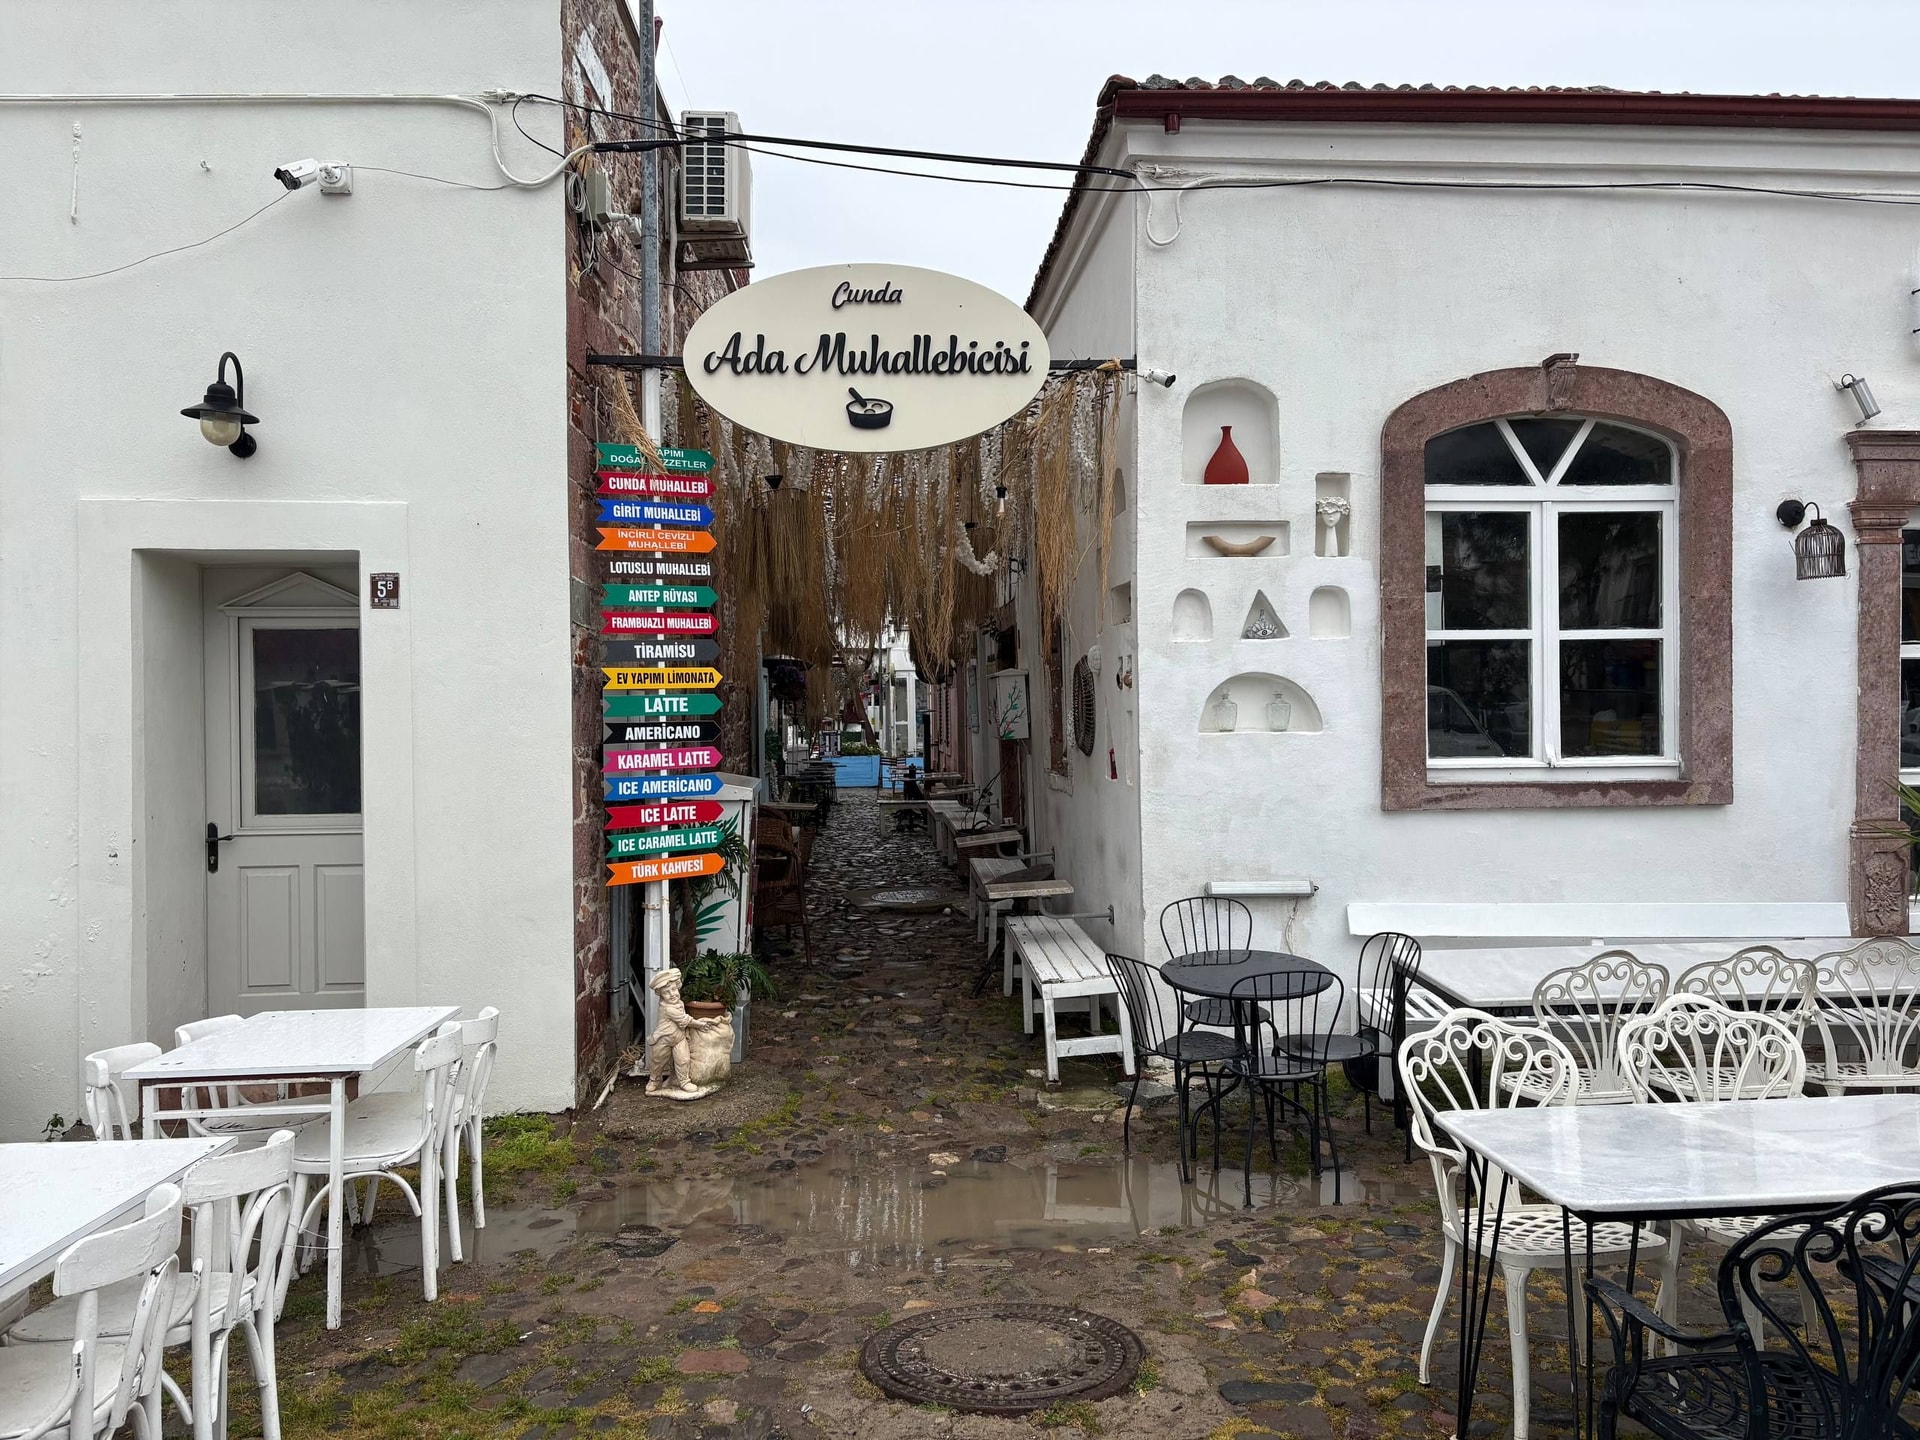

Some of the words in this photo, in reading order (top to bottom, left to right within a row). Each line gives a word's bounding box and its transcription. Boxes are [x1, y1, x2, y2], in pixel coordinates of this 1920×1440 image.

[831, 281, 903, 309] Cunda
[703, 331, 789, 376] Ada
[795, 332, 1033, 376] Muhallebicisi
[654, 448, 684, 457] APIMI
[609, 477, 646, 490] CUNDA
[650, 478, 708, 494] MUHALLEBİ
[613, 503, 641, 518] GİRİT
[644, 506, 700, 521] MUHALLEBİ
[618, 530, 655, 539] İNCİRLİ
[658, 531, 694, 540] CEVİZLİ
[629, 540, 686, 549] MUHALLEBİ
[610, 562, 653, 574] LOTUSLU
[656, 563, 710, 576] MUHALLEBİ
[629, 590, 660, 602] ANTEP
[663, 589, 697, 602] RÜYASI
[612, 616, 664, 628] FRAMBUAZLI
[667, 617, 711, 629] MUHALLEBİ
[634, 642, 695, 659] TİRAMİSU
[617, 673, 628, 684] EV
[631, 672, 664, 684] YAPIMI
[667, 670, 714, 684] LİMONATA
[645, 697, 688, 712] LATTE
[625, 723, 700, 740] AMERİCANO
[618, 753, 675, 769] KARAMEL
[678, 751, 711, 766] LATTE
[618, 782, 639, 795] ICE
[642, 777, 712, 794] AMERİCANO
[641, 809, 660, 823] ICE
[663, 806, 696, 821] LATTE
[618, 839, 635, 852] ICE
[638, 834, 687, 850] CARAMEL
[689, 831, 717, 845] LATTE
[631, 864, 658, 878] TÜRK
[661, 857, 703, 875] KAHVESİ
